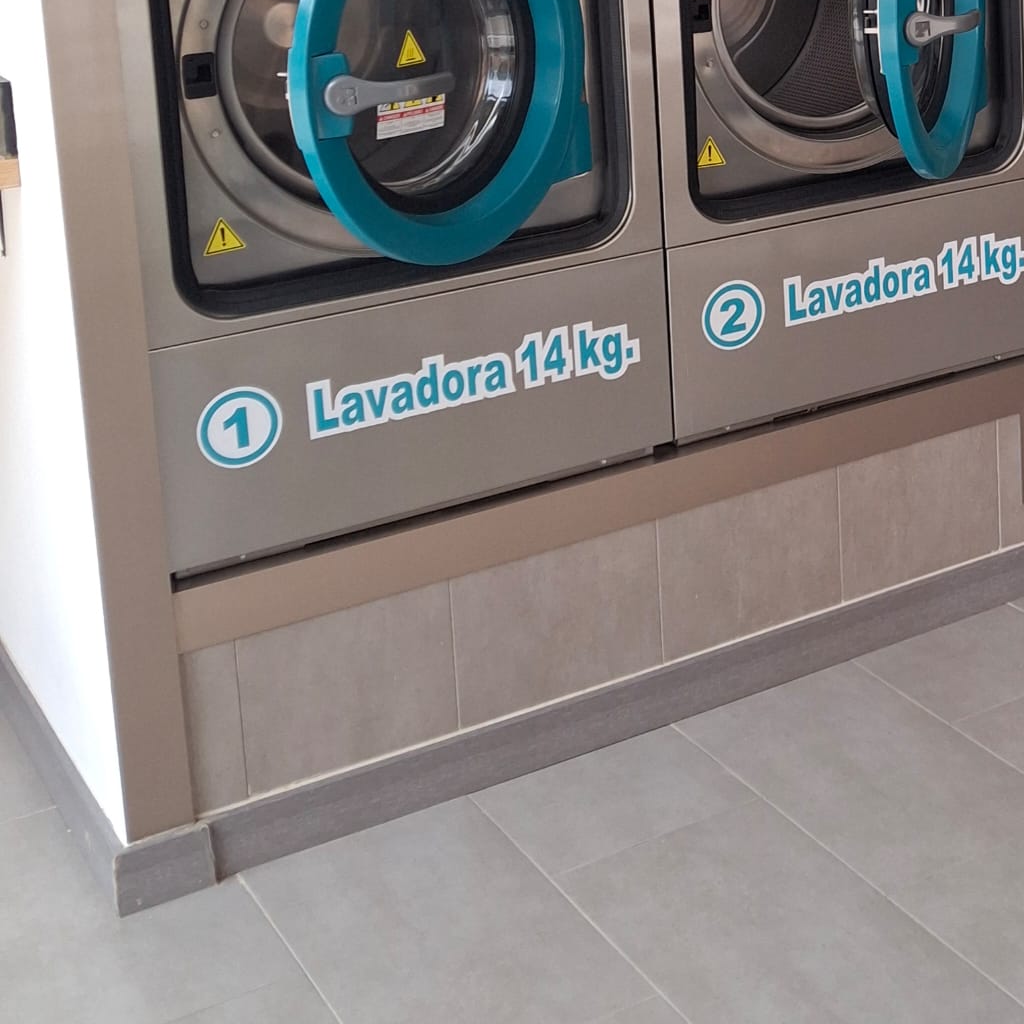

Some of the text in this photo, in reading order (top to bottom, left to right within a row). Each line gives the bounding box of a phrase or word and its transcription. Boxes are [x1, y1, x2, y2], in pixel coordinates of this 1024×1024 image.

[719, 297, 747, 336] 2
[786, 264, 931, 322] Lavadora
[940, 243, 976, 285] 14
[222, 328, 635, 450] 1 Lavadora 14 kg.
